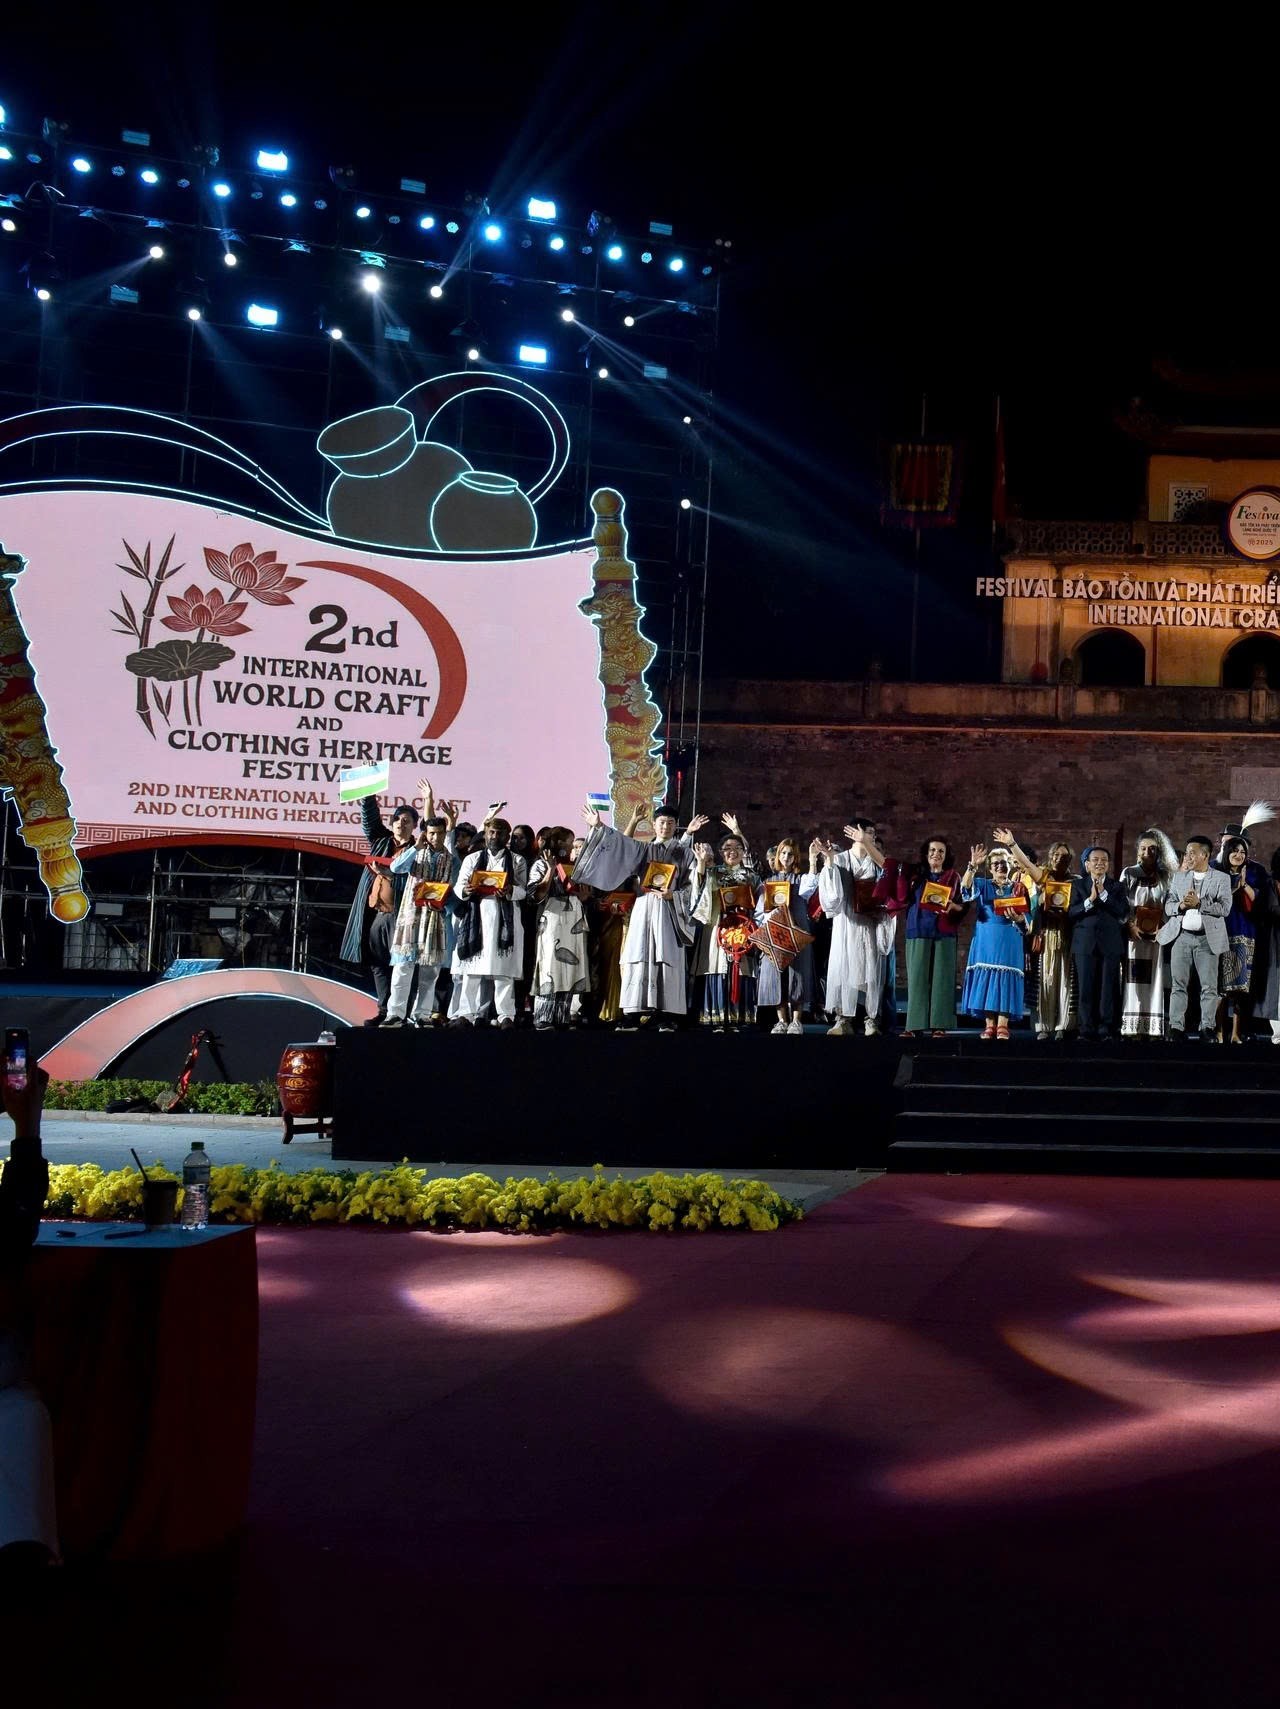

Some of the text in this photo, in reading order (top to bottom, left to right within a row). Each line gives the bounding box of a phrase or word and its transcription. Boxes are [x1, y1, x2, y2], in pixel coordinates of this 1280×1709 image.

[976, 577, 1056, 598] FESTIVAL
[1062, 573, 1104, 599] BẢO
[1109, 572, 1147, 600] TỒN
[1153, 577, 1180, 601] VÀ
[1186, 579, 1235, 602] PHÁT
[304, 604, 399, 653] 2nd
[1088, 604, 1234, 628] INTERNATIONAL
[242, 655, 427, 688] INTERNATIONAL
[213, 680, 430, 717] WORLD CRAFT
[296, 716, 343, 731] AND
[168, 729, 452, 766] CLOTHING HERITAGE
[242, 759, 352, 782] FESTIV
[128, 782, 170, 797] 2ND
[175, 784, 330, 805] INTERNATIONAL
[133, 801, 177, 815] AND
[181, 804, 278, 821] CLOTHING
[283, 809, 362, 825] HERITAG
